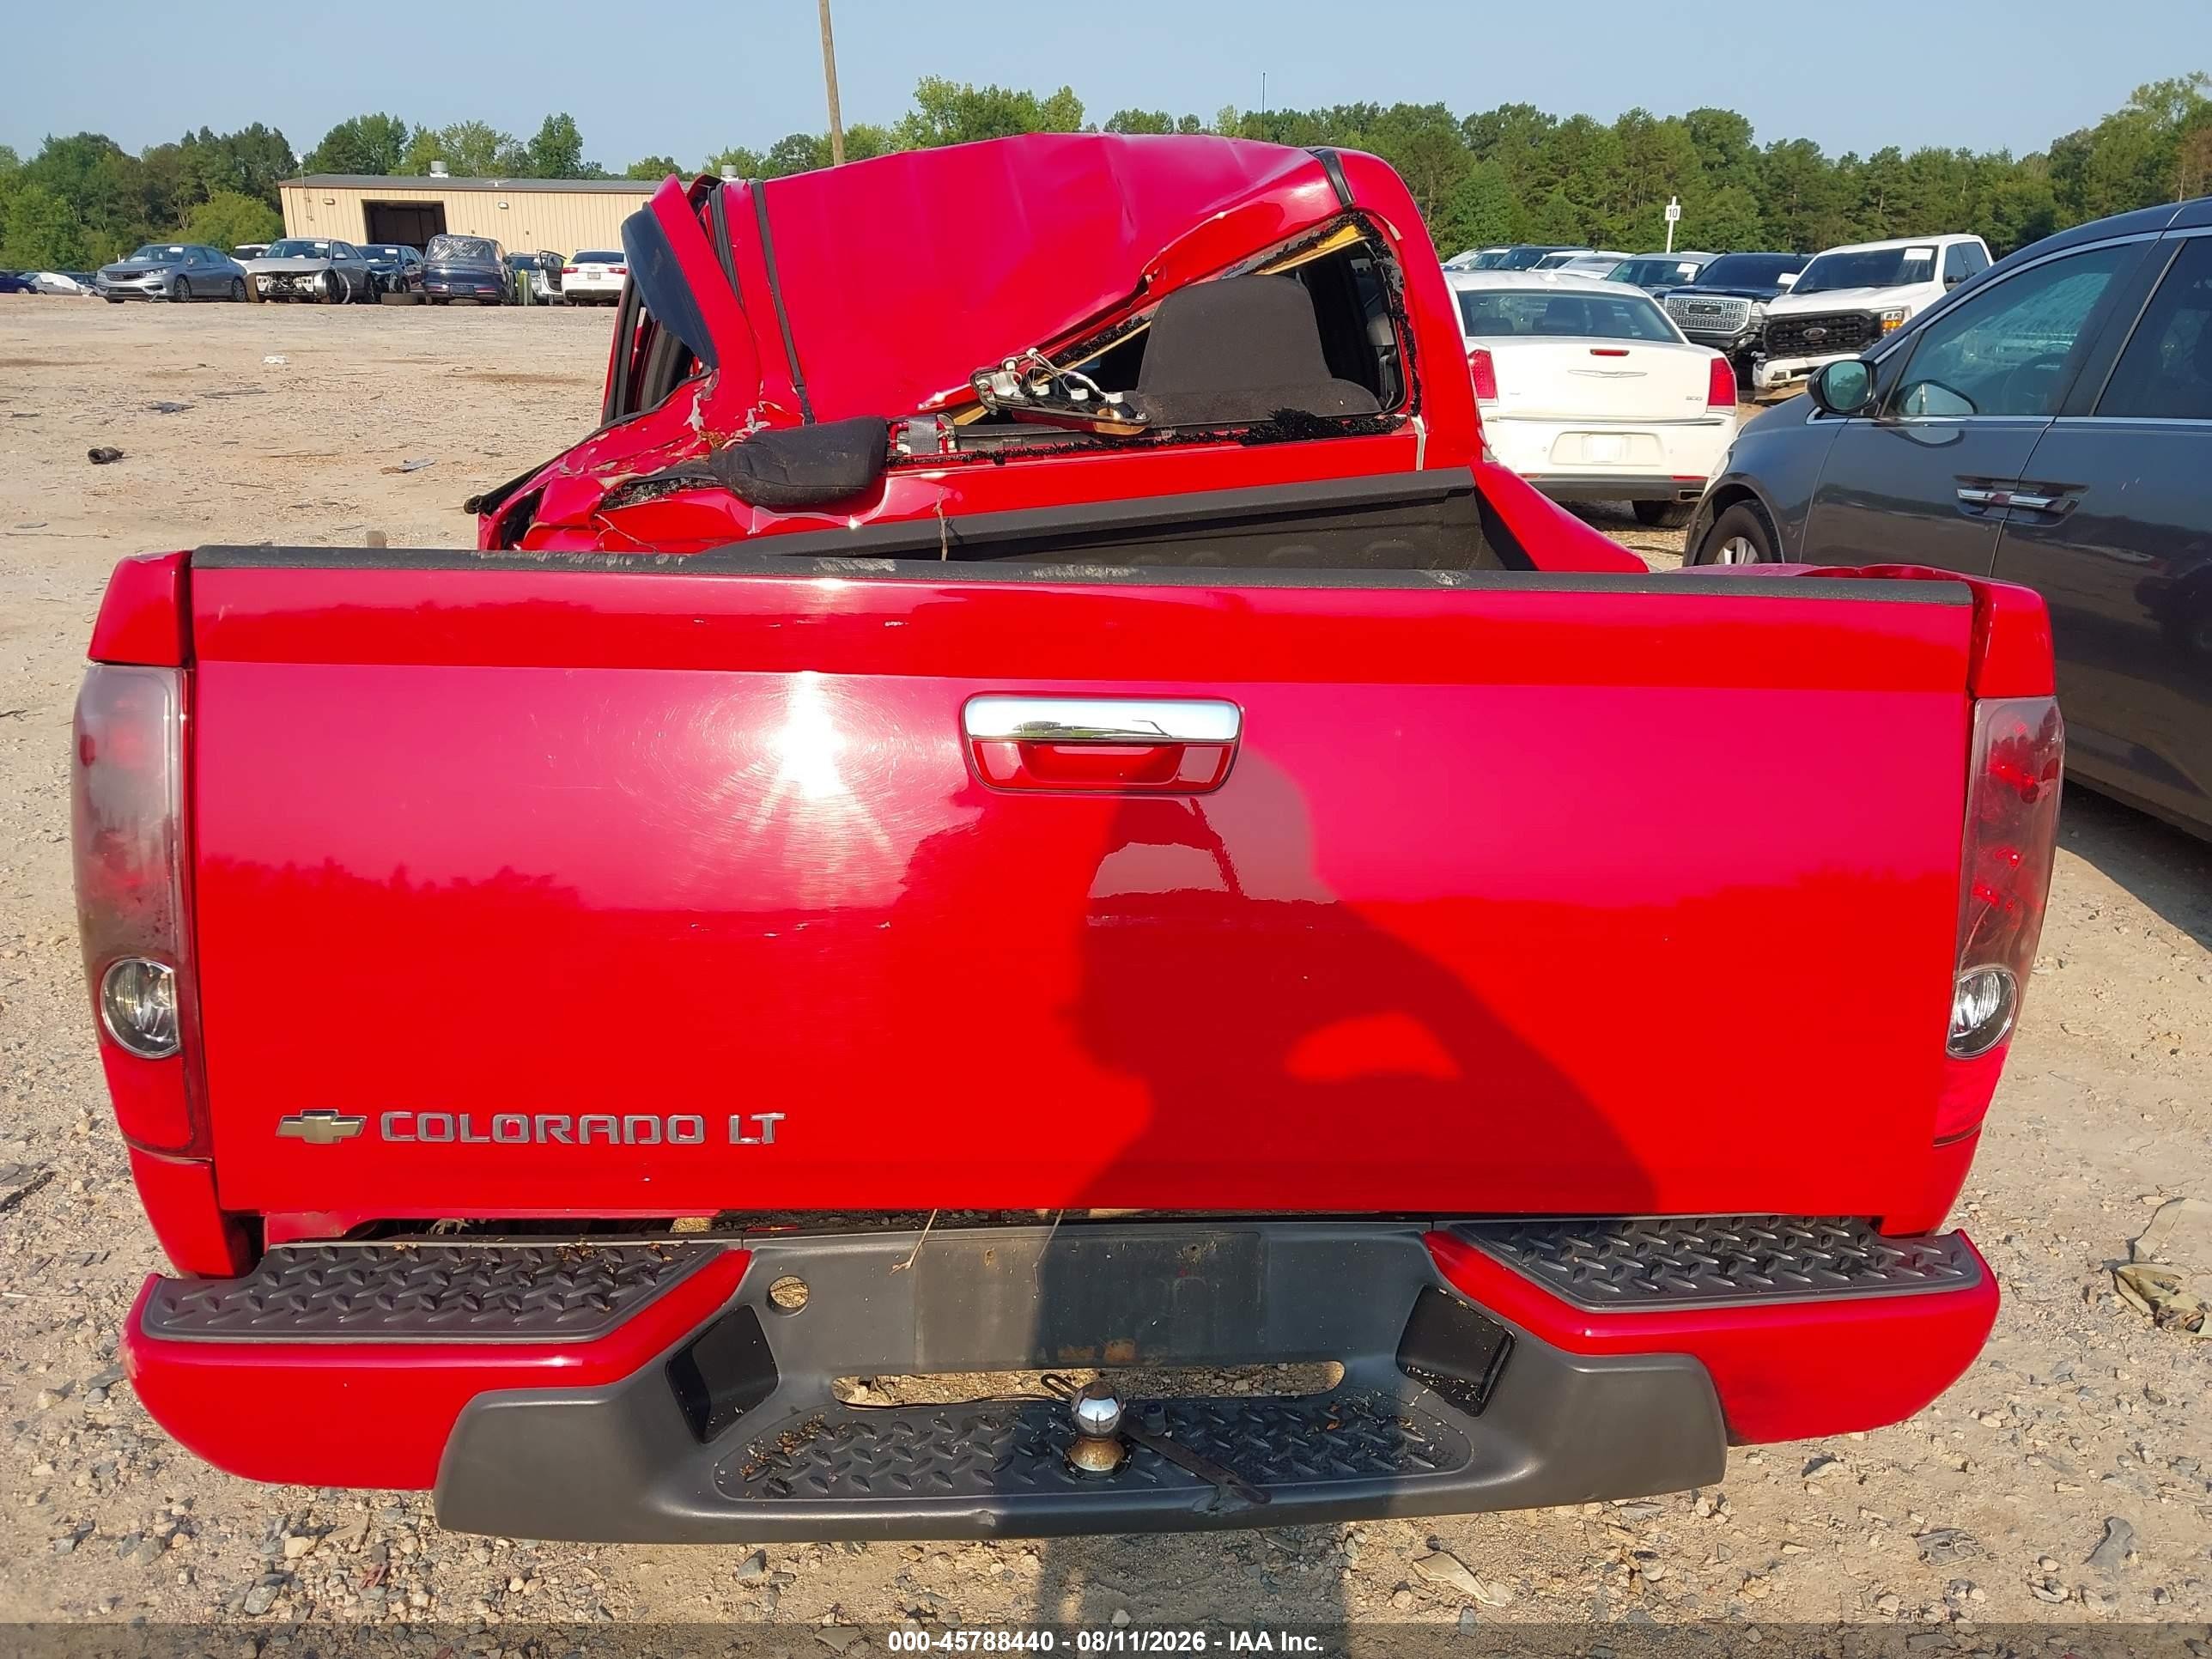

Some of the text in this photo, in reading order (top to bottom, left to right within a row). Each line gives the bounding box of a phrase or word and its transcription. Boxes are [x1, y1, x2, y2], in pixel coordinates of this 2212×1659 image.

[1668, 208, 1679, 218] 10
[380, 1110, 786, 1145] COLORADO LT
